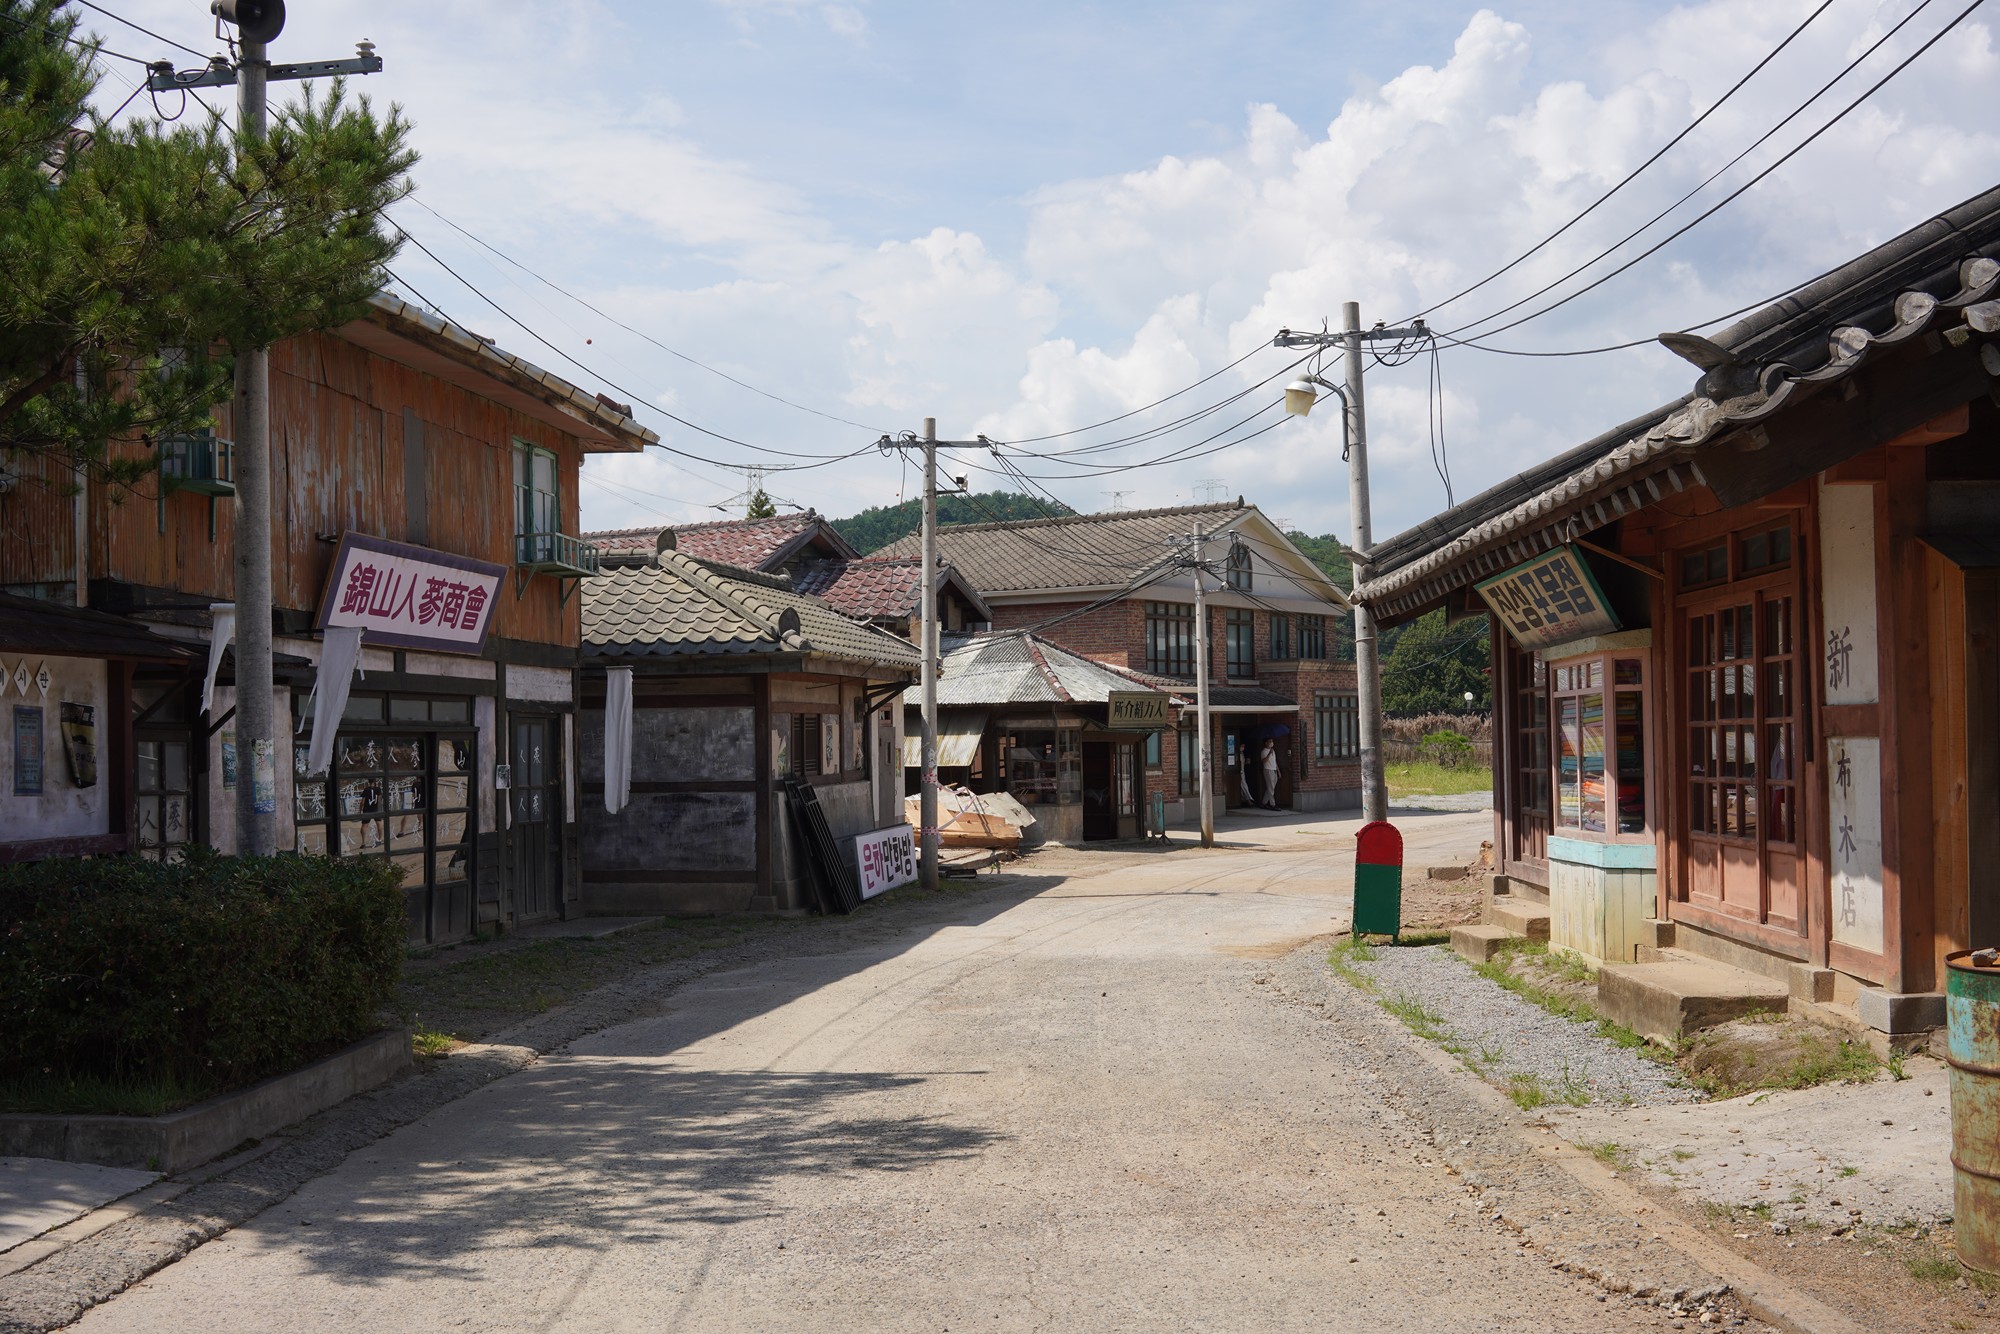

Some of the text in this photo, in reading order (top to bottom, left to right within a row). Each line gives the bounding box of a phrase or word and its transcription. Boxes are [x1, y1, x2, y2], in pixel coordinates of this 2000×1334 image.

[339, 561, 488, 631] 錦山人蔘商會
[1487, 556, 1596, 633] 진성포목점
